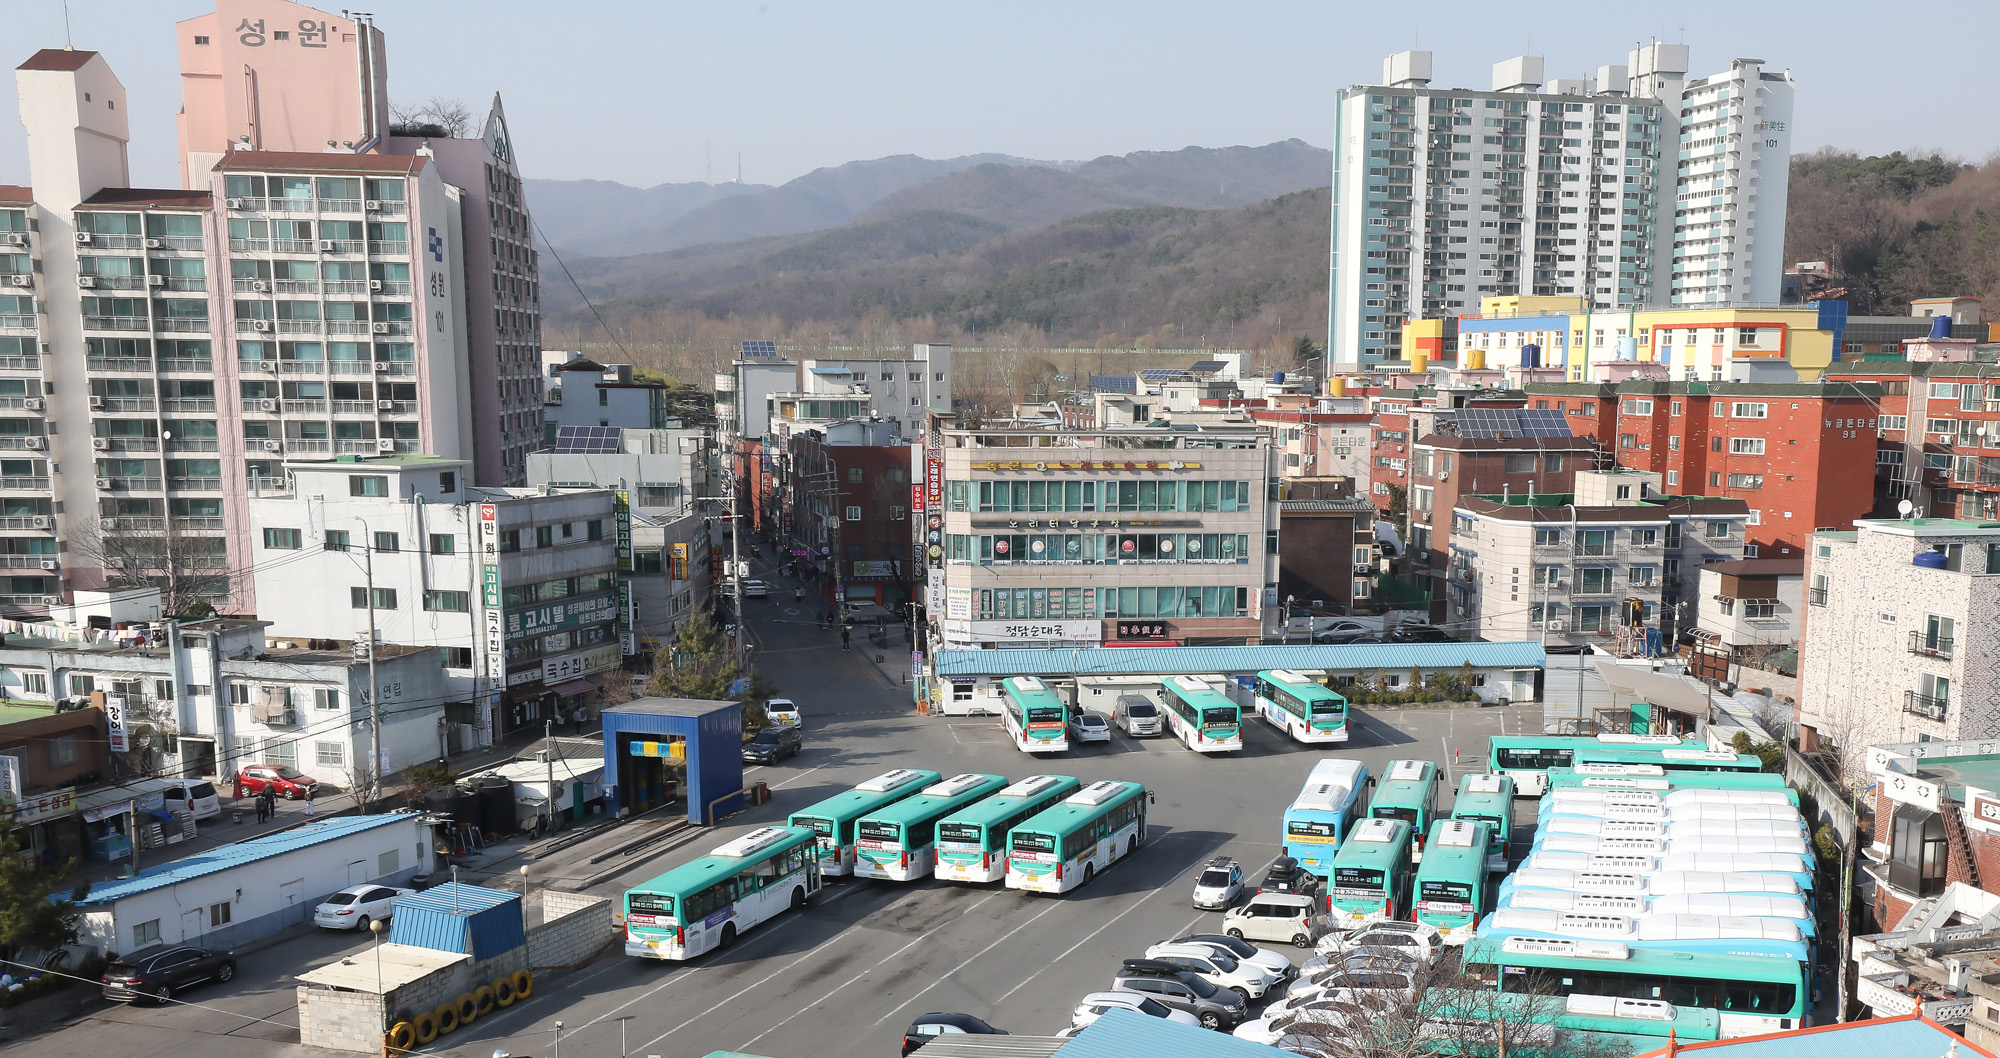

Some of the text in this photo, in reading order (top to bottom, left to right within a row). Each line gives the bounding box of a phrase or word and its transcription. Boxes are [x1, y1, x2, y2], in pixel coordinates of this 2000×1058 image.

[1765, 139, 1778, 148] 101
[435, 310, 445, 333] 101
[525, 605, 565, 628] 고시텔
[488, 611, 499, 652] 국수집
[1005, 625, 1063, 637] 정담순대국
[547, 658, 581, 679] 국수집
[109, 707, 120, 729] 장어
